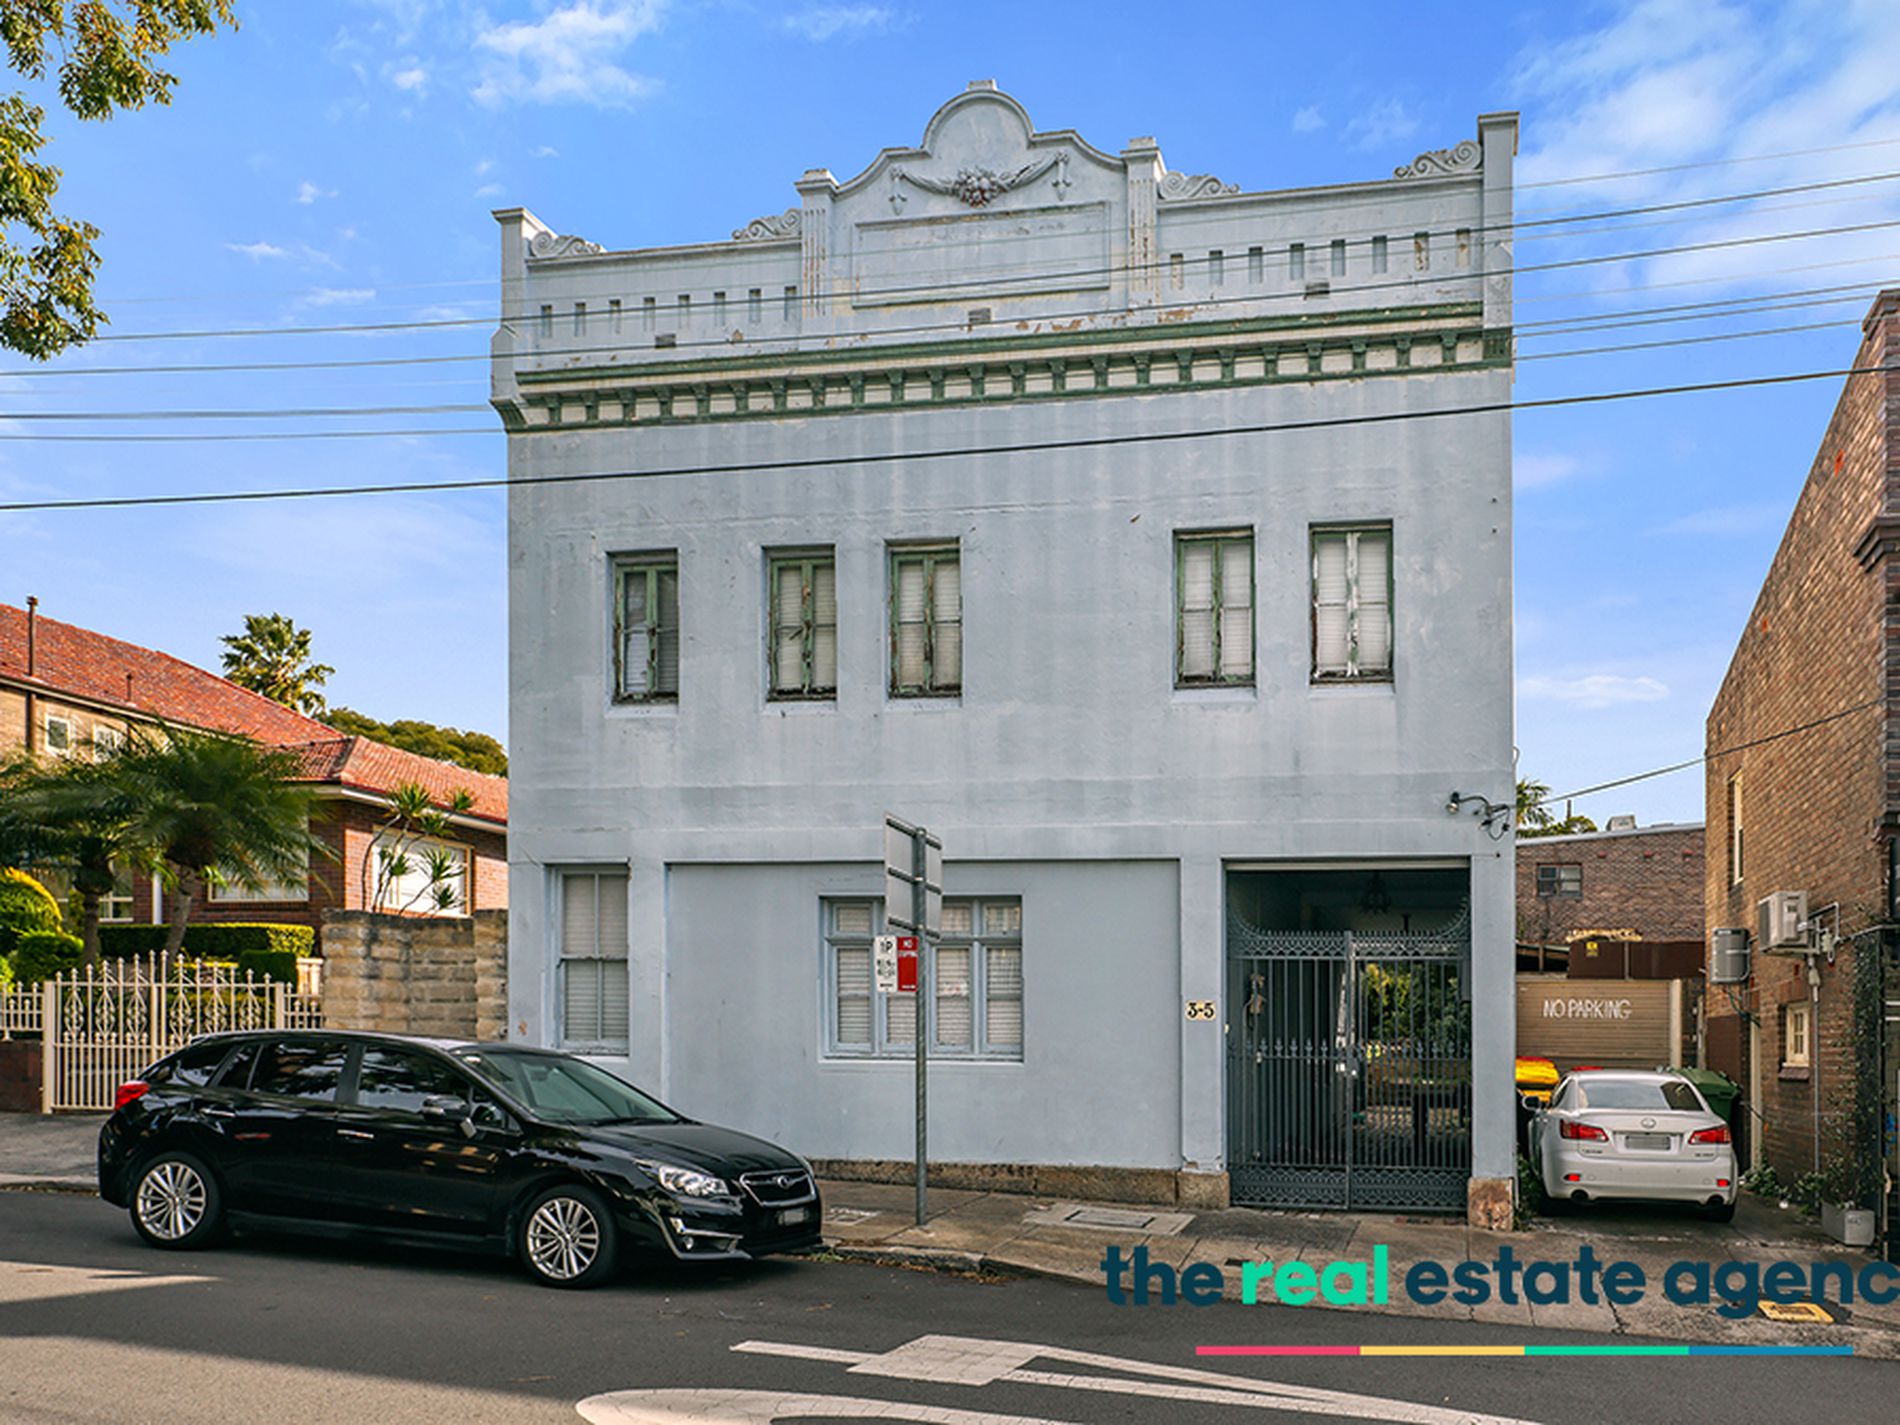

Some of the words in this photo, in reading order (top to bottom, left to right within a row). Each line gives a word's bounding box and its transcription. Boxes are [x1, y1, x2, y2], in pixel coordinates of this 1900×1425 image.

[1188, 1002, 1214, 1018] 3-5
[1543, 999, 1565, 1018] NO
[1568, 999, 1632, 1019] PARKING
